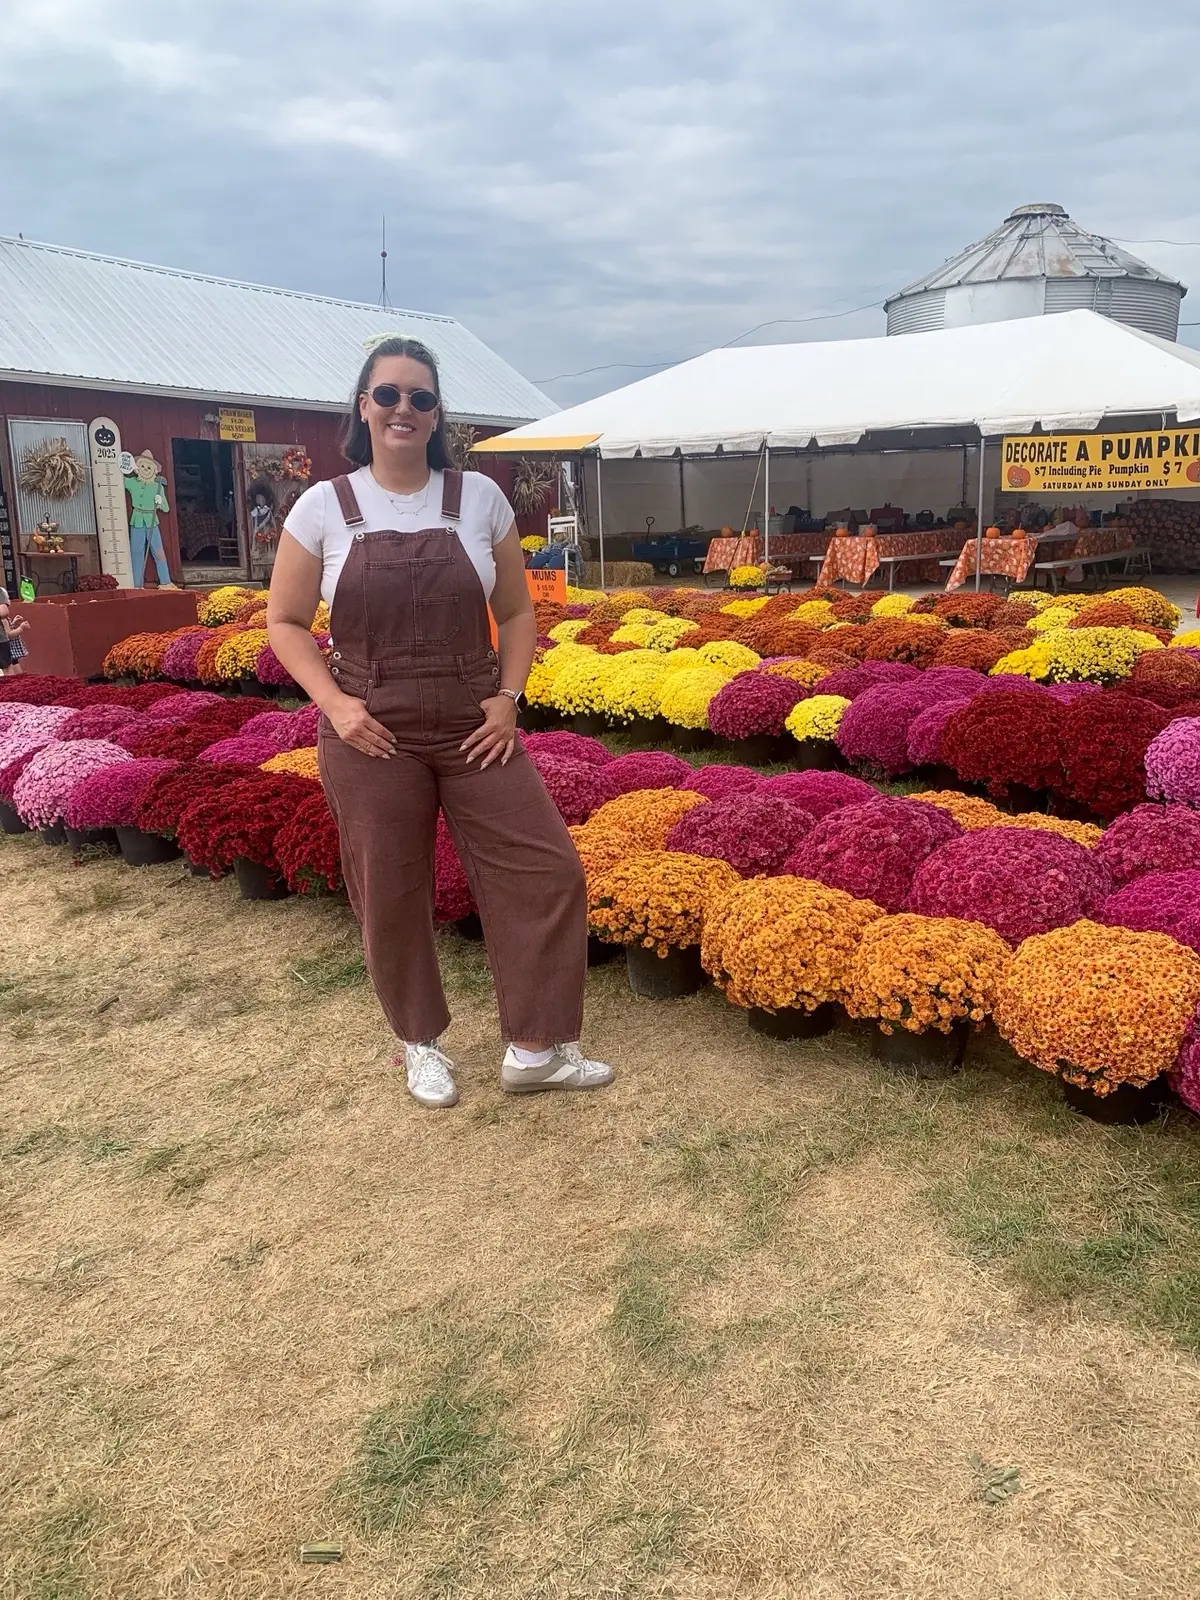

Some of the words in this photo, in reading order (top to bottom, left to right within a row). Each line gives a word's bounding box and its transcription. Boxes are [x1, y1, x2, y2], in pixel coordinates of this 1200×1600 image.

[97, 448, 116, 458] 2025
[1006, 442, 1068, 463] DECORATE
[1076, 440, 1090, 462] A
[1101, 434, 1200, 460] PUMPKI
[1049, 465, 1087, 478] Including
[1089, 465, 1102, 476] Pie
[1109, 463, 1149, 476] Pumpkin
[1174, 462, 1182, 473] 7
[532, 571, 557, 581] MUMS
